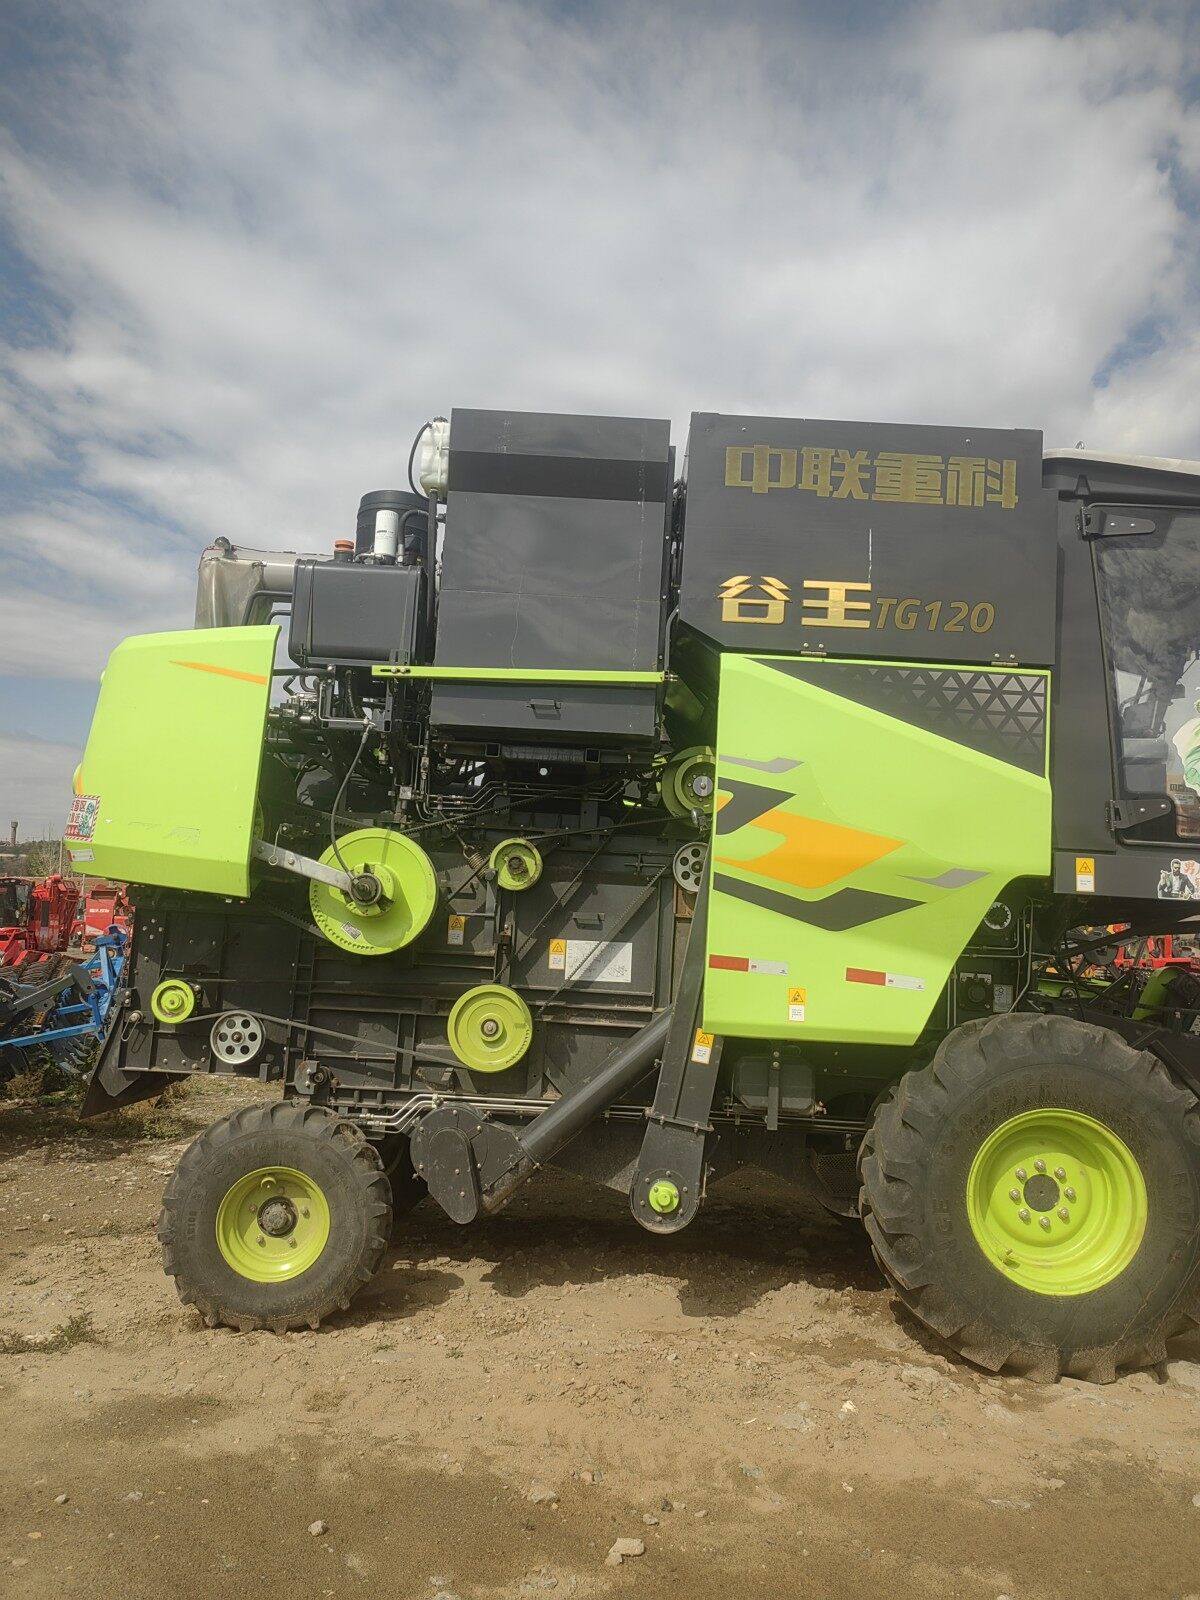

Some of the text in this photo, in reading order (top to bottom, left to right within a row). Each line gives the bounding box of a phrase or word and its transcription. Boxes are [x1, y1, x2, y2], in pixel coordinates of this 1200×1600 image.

[725, 444, 1019, 509] 中联重科
[718, 575, 996, 634] 谷王 TG120
